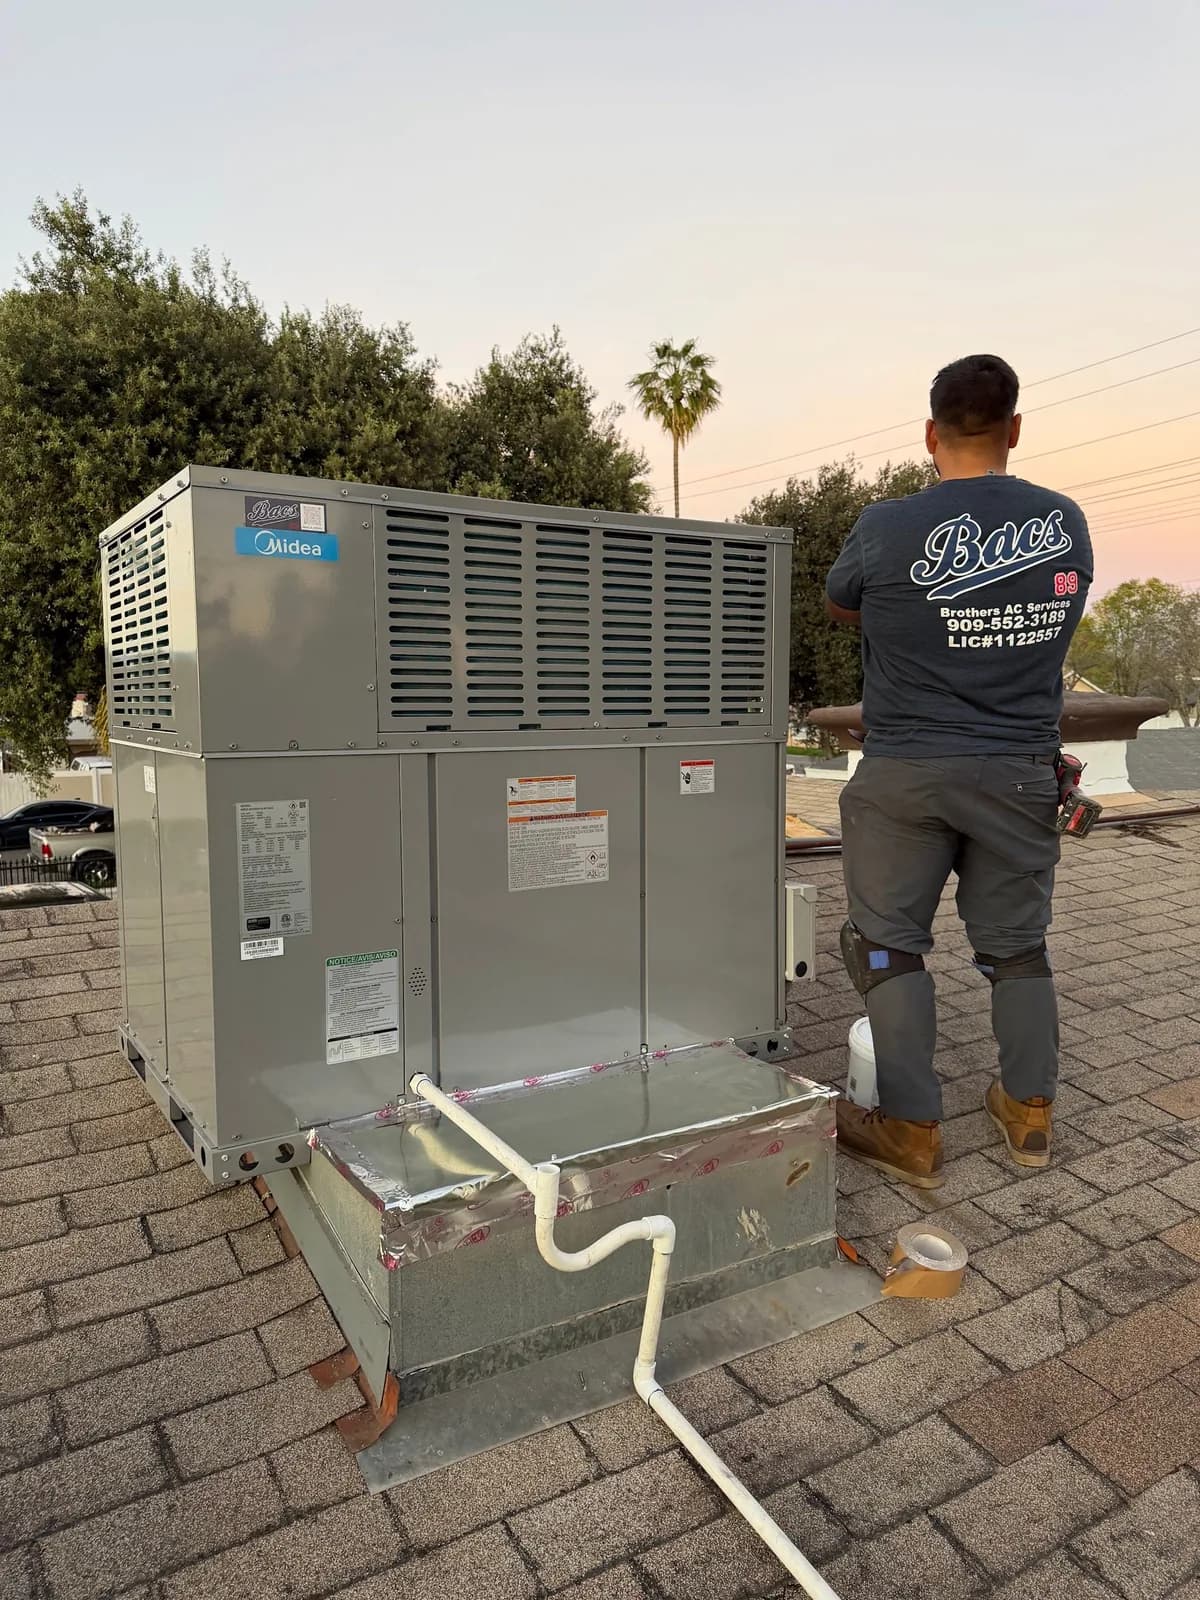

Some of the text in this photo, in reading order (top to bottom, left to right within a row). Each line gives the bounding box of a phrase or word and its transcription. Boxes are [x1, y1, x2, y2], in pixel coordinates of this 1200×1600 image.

[247, 499, 300, 520] Bacs
[254, 530, 323, 556] Midea
[910, 509, 1072, 586] Bacs
[1054, 571, 1078, 596] 89
[940, 599, 1071, 618] Brothers AC Services
[946, 609, 1066, 632] 909-552-3189
[948, 626, 1062, 648] LIC#1122557
